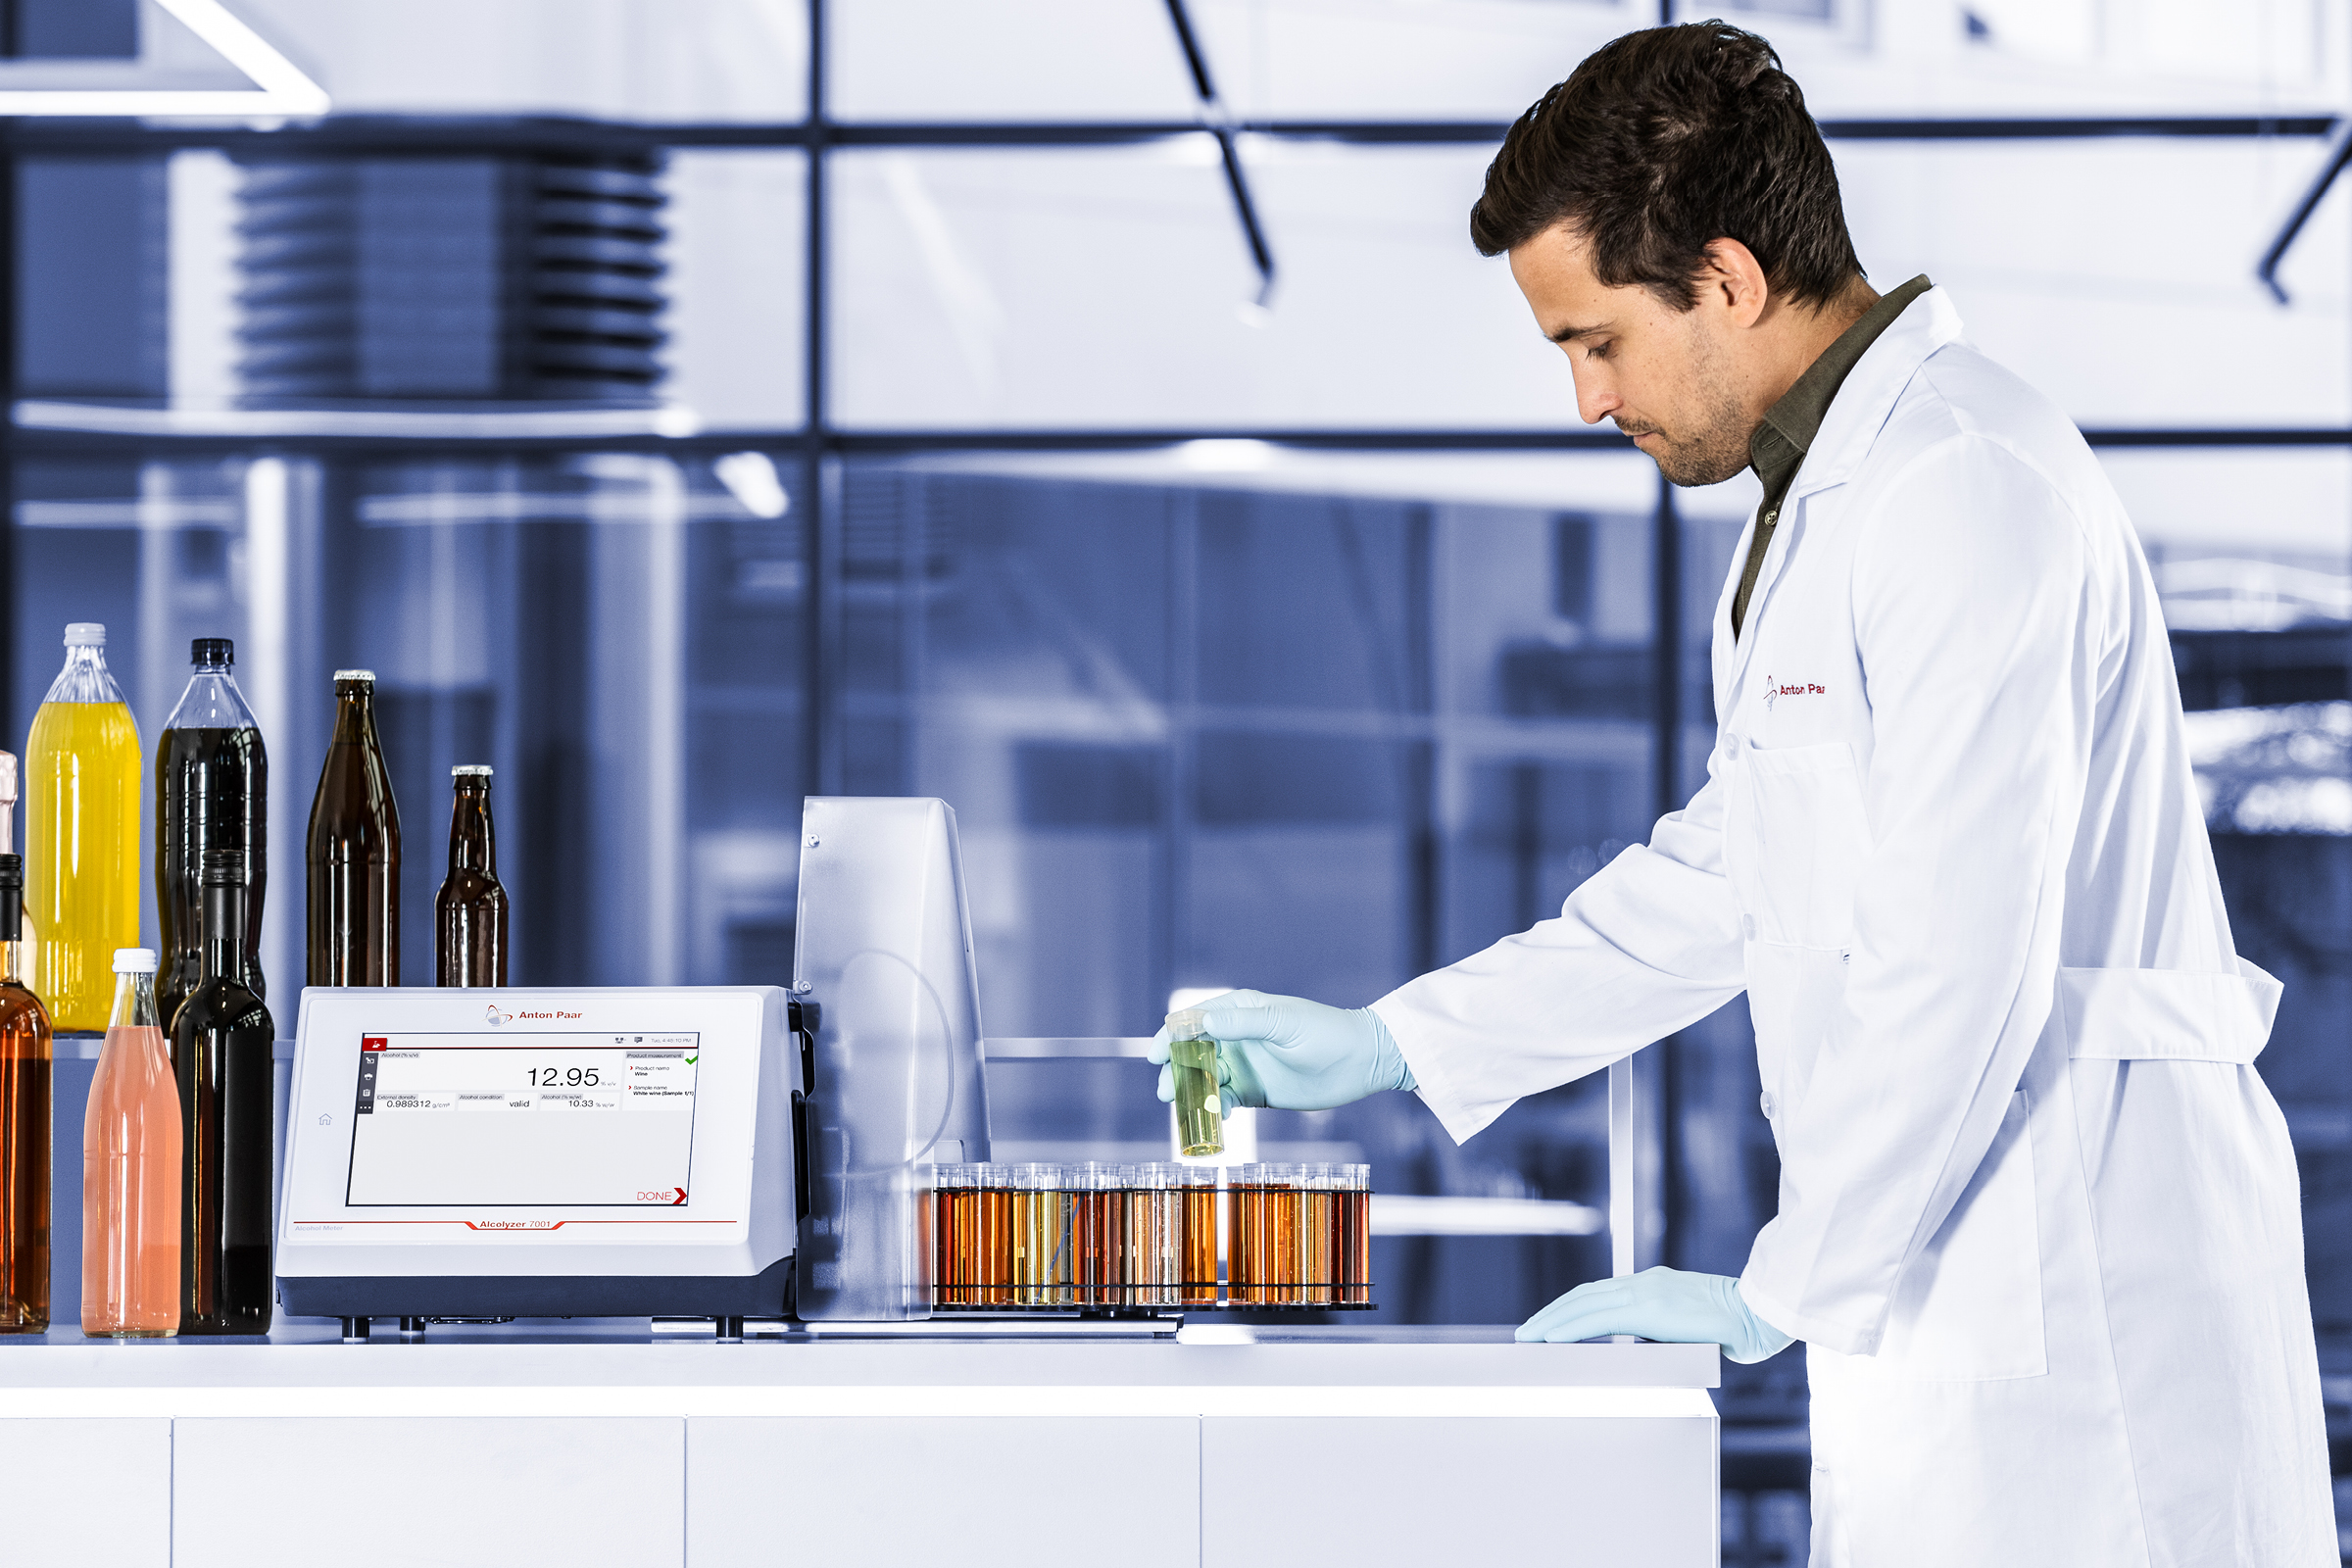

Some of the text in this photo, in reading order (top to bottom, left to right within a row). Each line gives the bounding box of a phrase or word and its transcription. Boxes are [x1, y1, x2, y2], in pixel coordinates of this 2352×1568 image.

[1780, 684, 1805, 695] Anton
[518, 1010, 582, 1019] Anton Paar
[527, 1067, 600, 1087] 12.95
[386, 1100, 431, 1108] 0.989312
[636, 1191, 672, 1201] DONE
[479, 1220, 527, 1229] Alcolyzer
